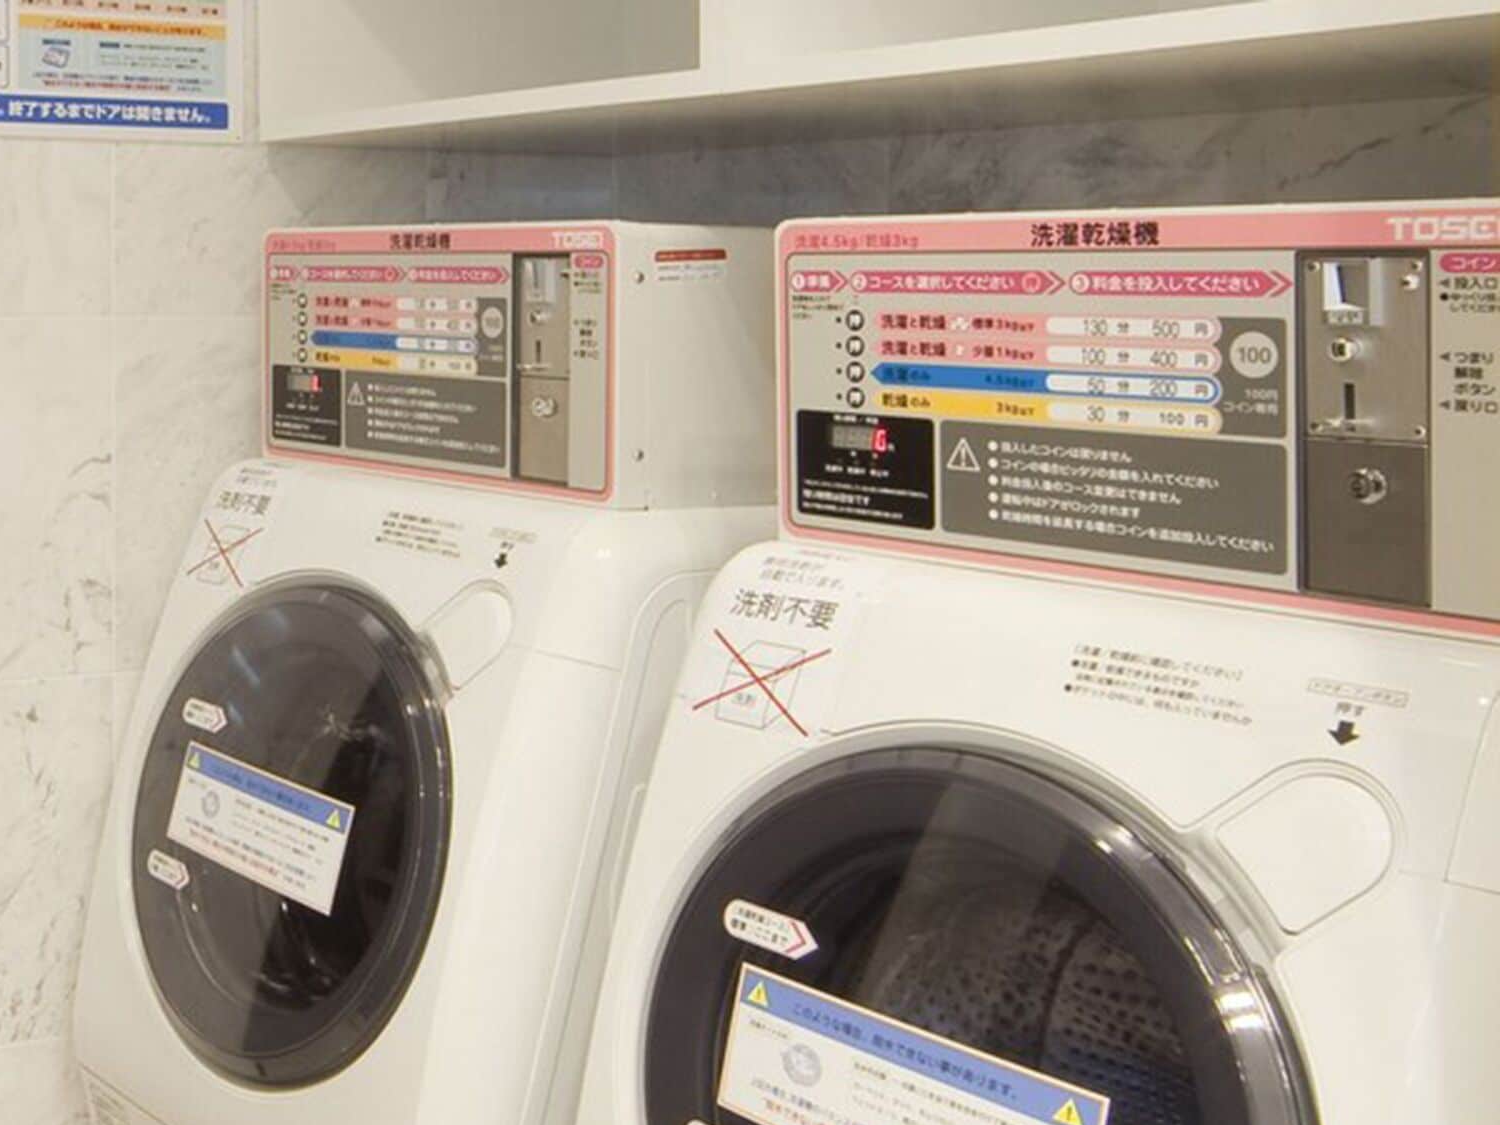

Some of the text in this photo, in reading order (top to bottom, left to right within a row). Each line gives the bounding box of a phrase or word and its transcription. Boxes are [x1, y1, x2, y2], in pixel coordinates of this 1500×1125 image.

[1030, 221, 1160, 247] 洗濯乾燥機
[1450, 256, 1497, 270] コイン
[1083, 319, 1108, 336] 130
[1151, 320, 1181, 338] 500
[1081, 348, 1107, 366] 100
[1149, 350, 1179, 368] 400
[1237, 346, 1273, 365] 100
[1453, 352, 1495, 365] つまり
[1086, 377, 1107, 395] 50
[1149, 379, 1179, 397] 200
[1453, 382, 1496, 396] ボタン
[1086, 405, 1107, 423] 30
[1158, 411, 1186, 426] 100
[729, 587, 841, 631] 洗剤不要
